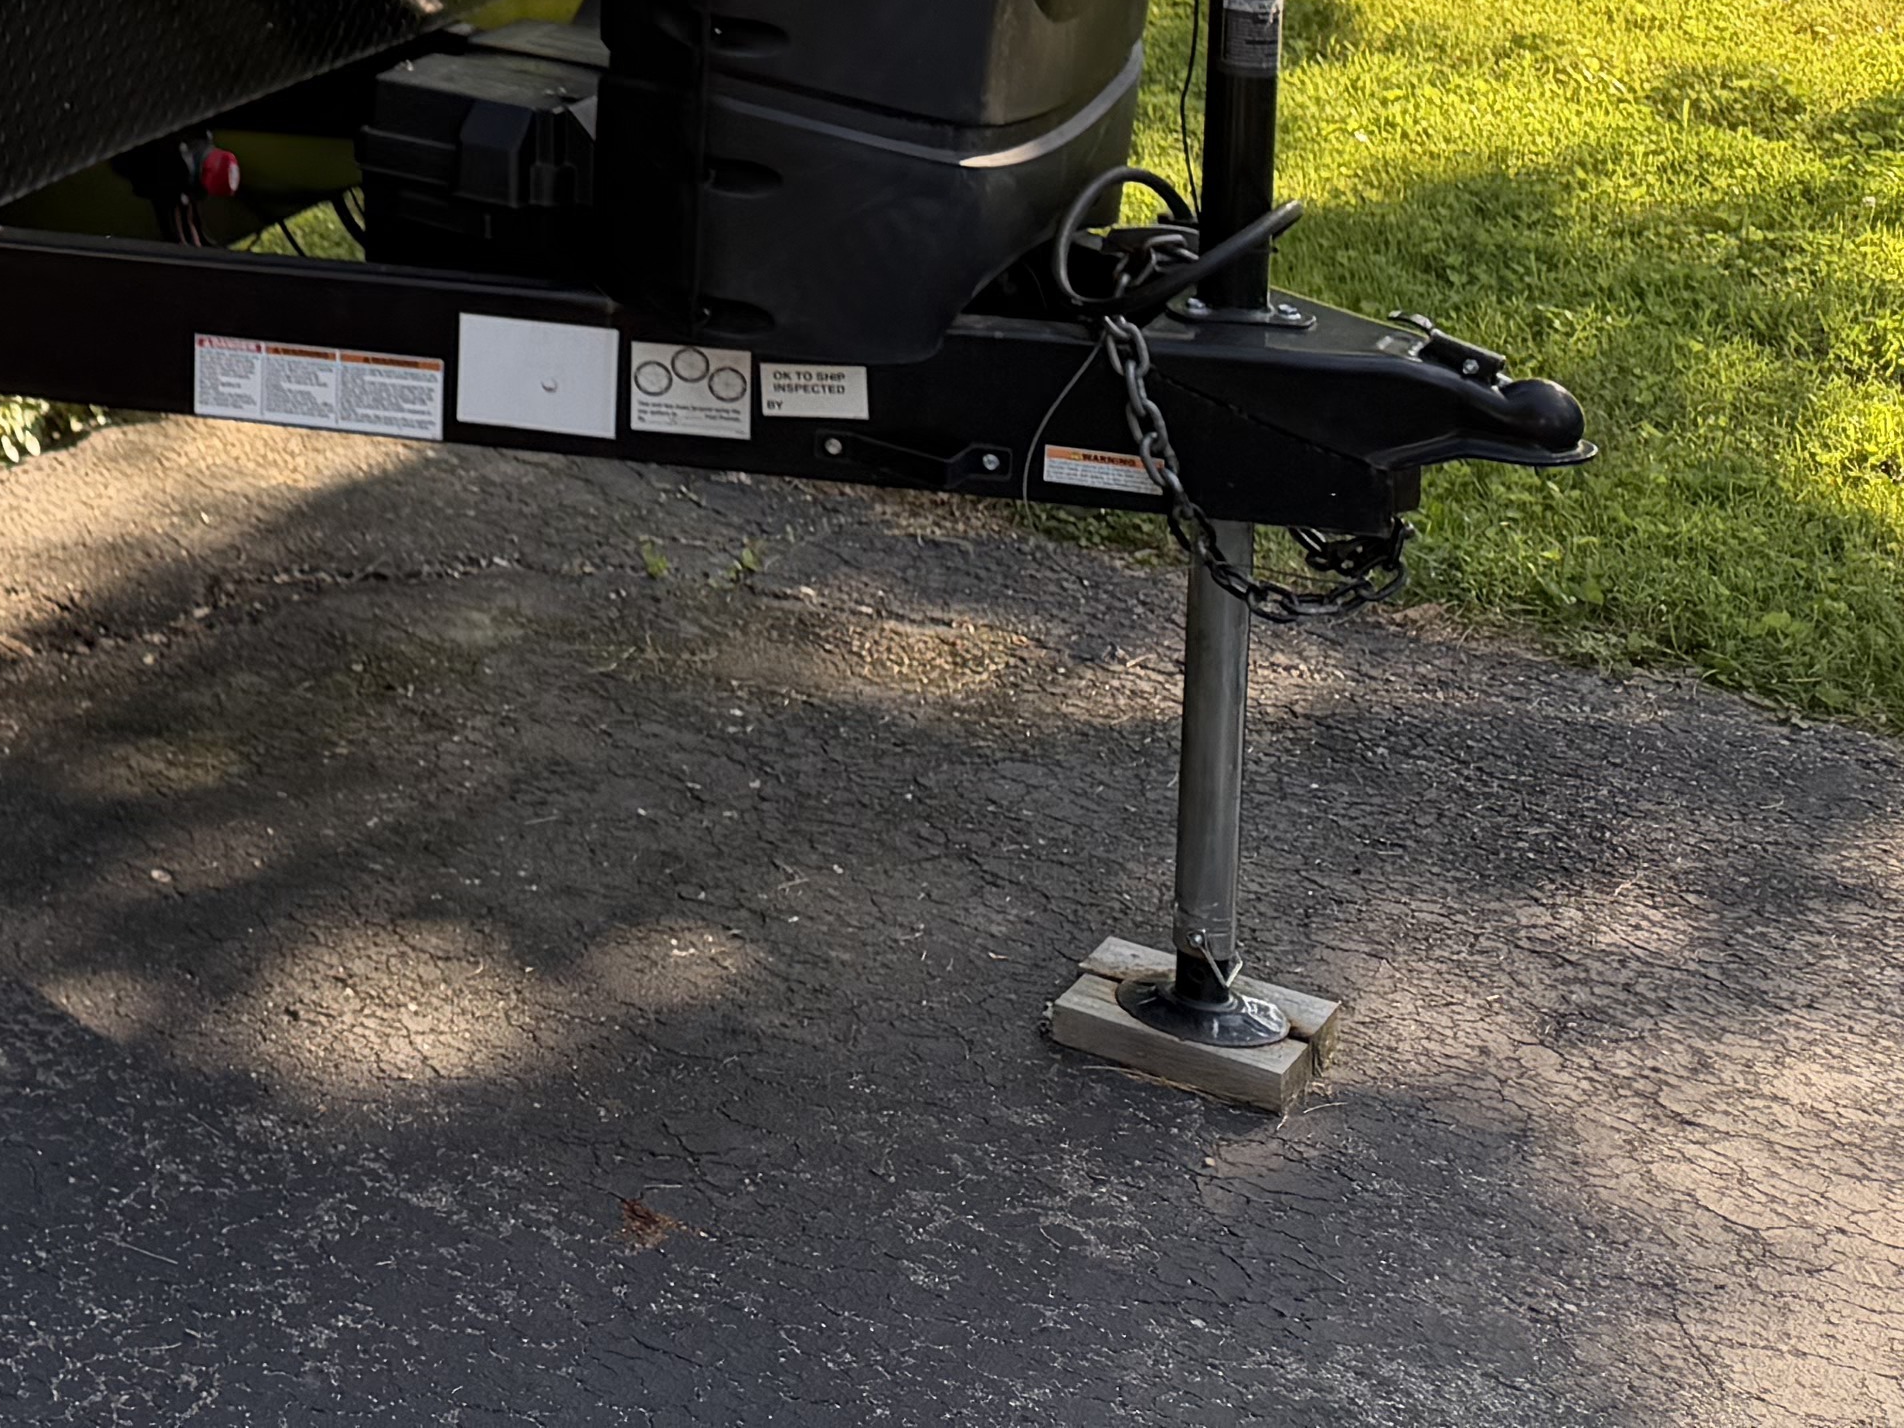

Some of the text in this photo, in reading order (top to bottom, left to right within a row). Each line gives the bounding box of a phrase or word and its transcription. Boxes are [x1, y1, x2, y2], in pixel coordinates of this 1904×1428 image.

[773, 370, 845, 382] OK TO SHIP
[773, 383, 845, 394] INSPECTED
[766, 400, 783, 410] BY
[1082, 453, 1136, 466] WARNING
